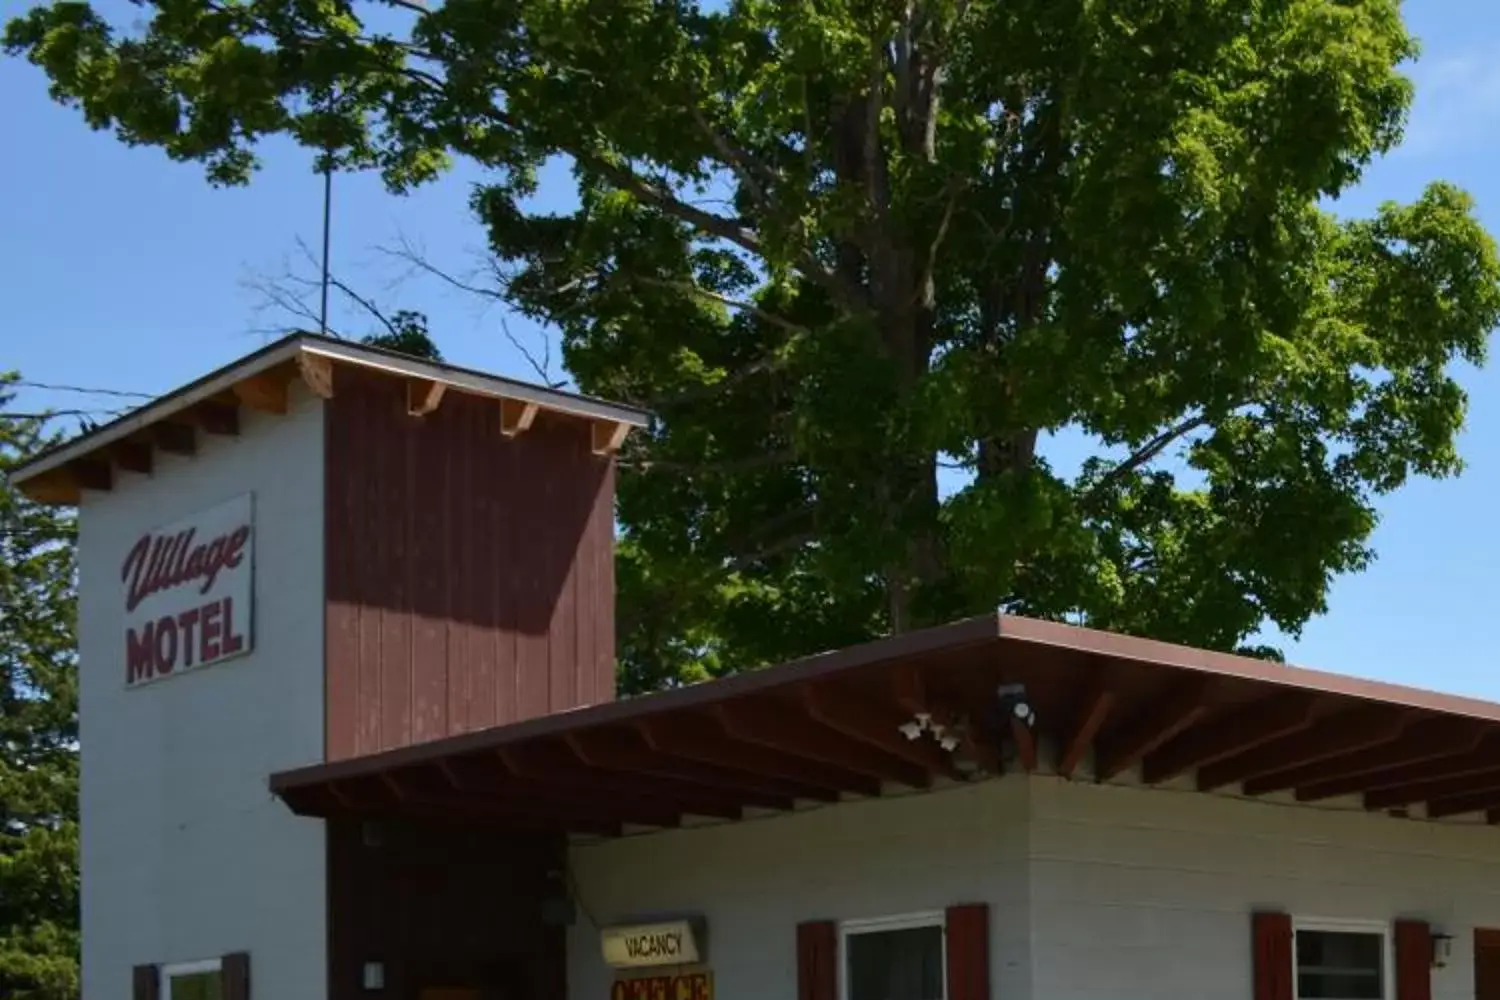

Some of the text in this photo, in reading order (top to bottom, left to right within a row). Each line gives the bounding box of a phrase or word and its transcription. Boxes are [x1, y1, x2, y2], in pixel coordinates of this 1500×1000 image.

[121, 524, 249, 612] Village
[126, 597, 243, 684] MOTEL
[624, 932, 682, 957] VACANCY
